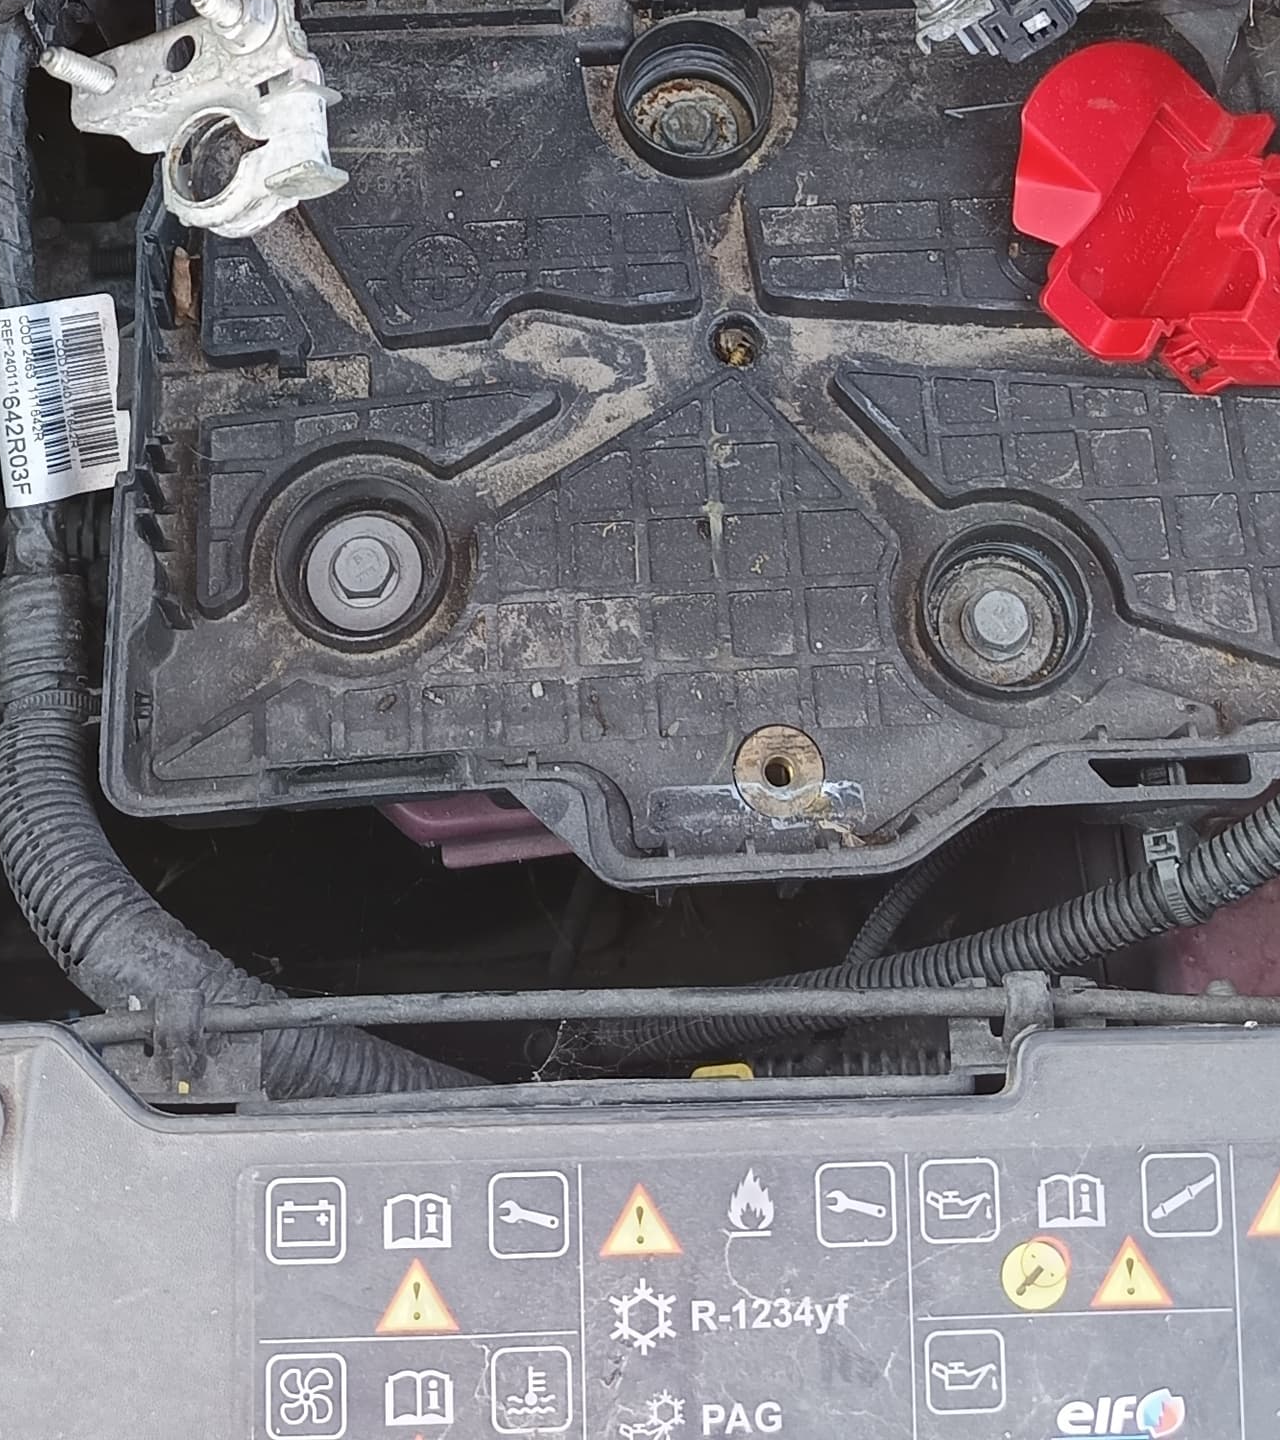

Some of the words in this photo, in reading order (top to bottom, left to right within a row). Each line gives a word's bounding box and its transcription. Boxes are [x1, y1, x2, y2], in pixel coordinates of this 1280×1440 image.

[18, 314, 33, 345] COD
[690, 1294, 851, 1335] R-1234yf
[701, 1400, 783, 1437] PAG
[1056, 1394, 1138, 1436] elf
